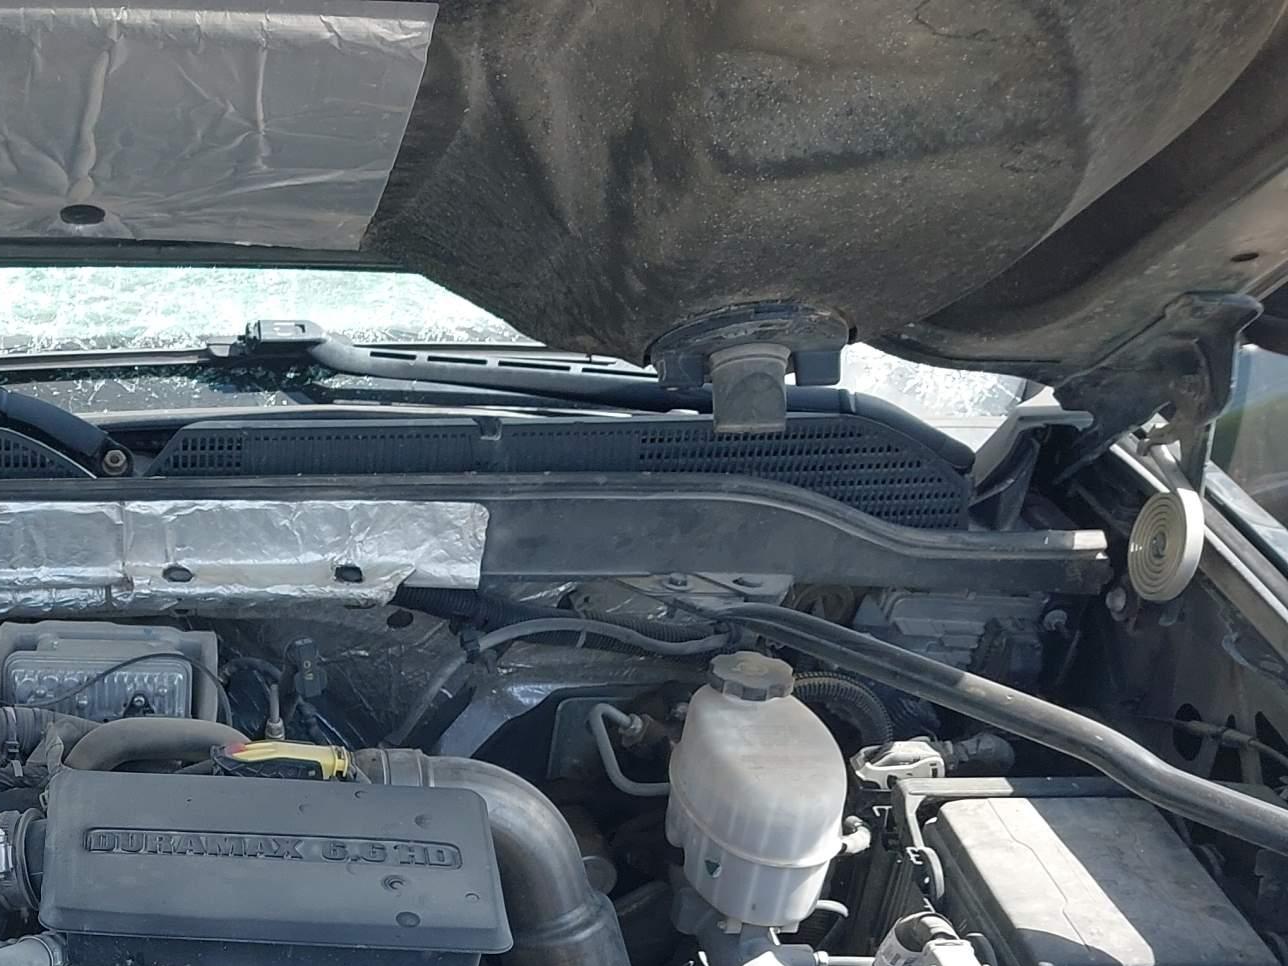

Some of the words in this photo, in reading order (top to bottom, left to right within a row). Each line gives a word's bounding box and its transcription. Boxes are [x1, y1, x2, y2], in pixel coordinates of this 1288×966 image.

[90, 831, 304, 859] DURAMAX
[321, 842, 387, 863] 6.6
[398, 844, 457, 867] HD
